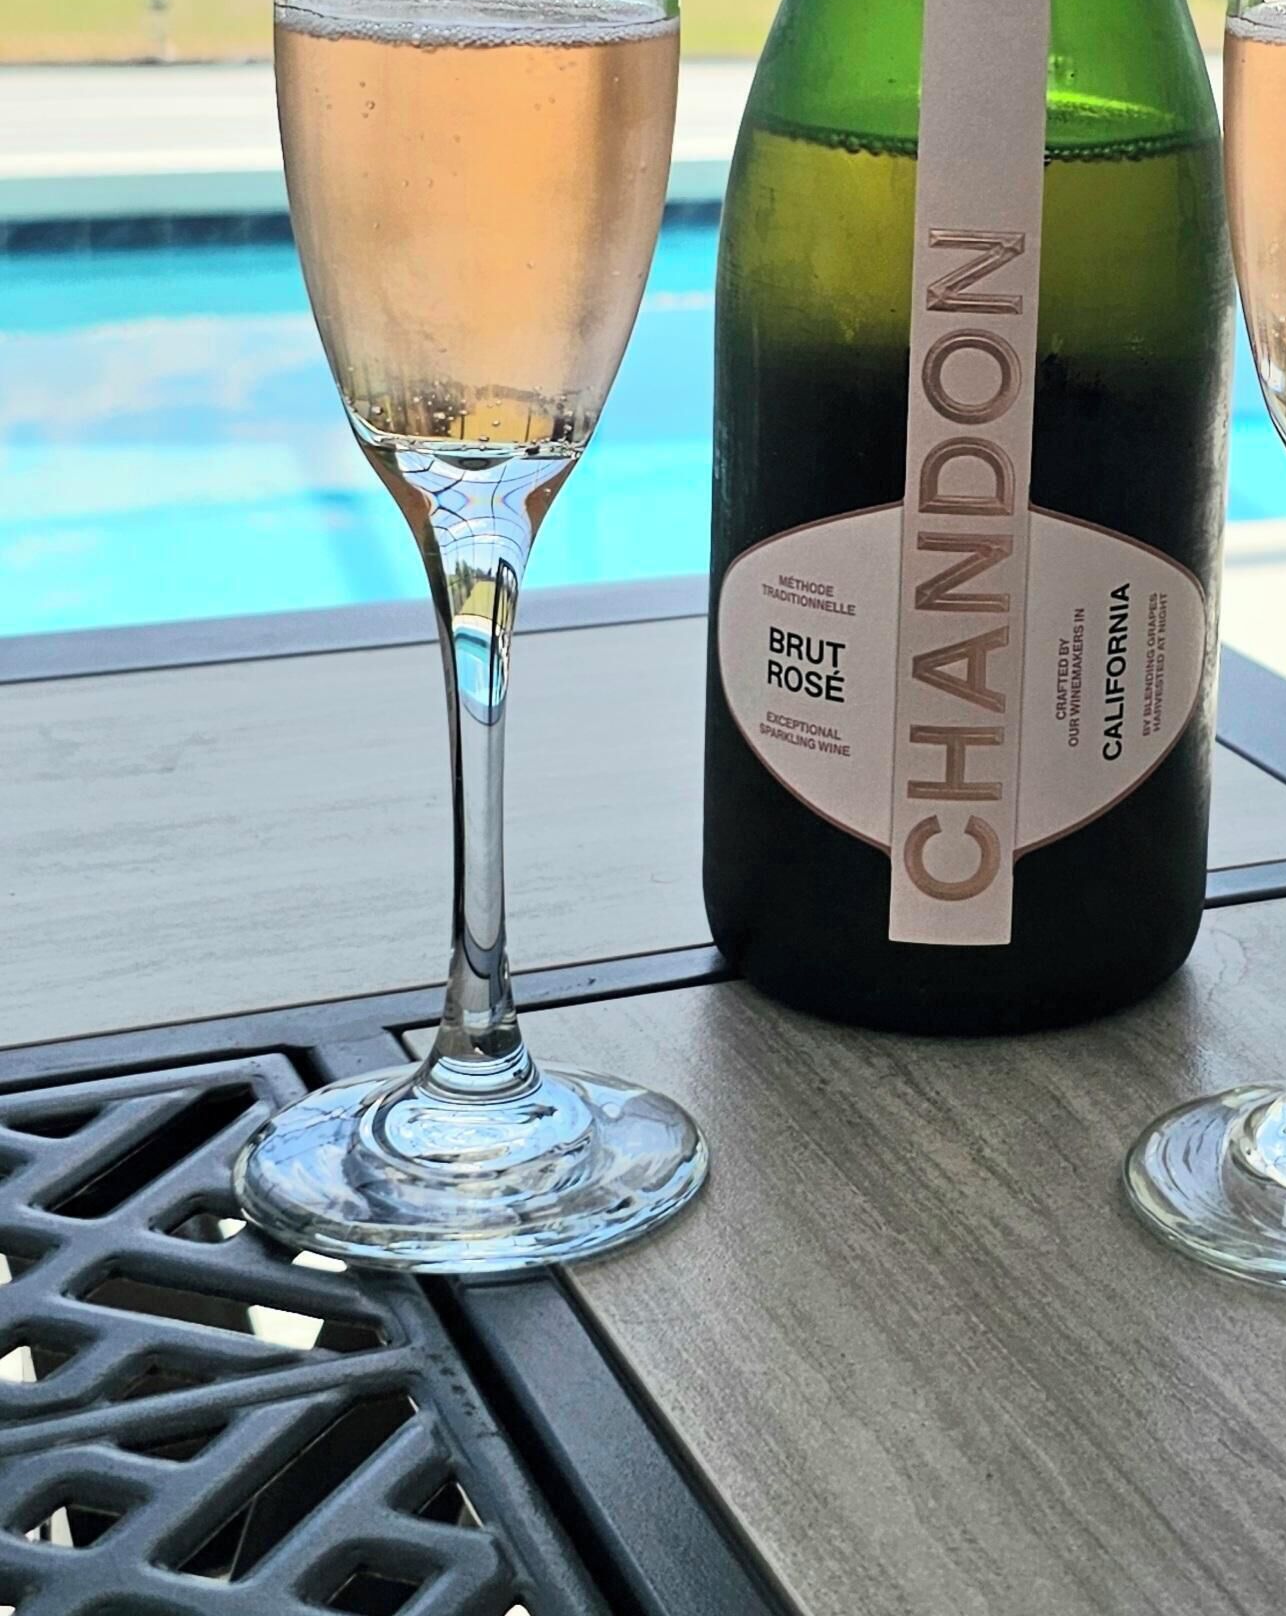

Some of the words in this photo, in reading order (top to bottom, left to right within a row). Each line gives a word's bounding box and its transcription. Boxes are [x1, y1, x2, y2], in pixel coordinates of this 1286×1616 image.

[903, 228, 1025, 901] CHANDON
[761, 583, 857, 616] TRADITIONNELLE
[778, 574, 834, 597] MÉTHODE
[1074, 608, 1085, 622] IN
[1147, 592, 1158, 646] GRAPES
[1158, 592, 1168, 633] NIGHT
[769, 626, 846, 668] BRUT
[1059, 638, 1070, 656] BY
[1157, 636, 1166, 651] AT
[767, 659, 845, 703] ROSÉ
[1056, 658, 1069, 720] CRAFTED
[1070, 625, 1084, 717] WINEMAKERS
[1103, 583, 1130, 761] CALIFORNIA
[1144, 650, 1155, 717] BLENDING
[1153, 654, 1165, 732] HARVESTED
[760, 722, 816, 750] SPARKLING
[818, 740, 851, 757] WINE
[766, 711, 842, 740] EXCEPTIONAL
[1068, 718, 1080, 747] OUR
[1142, 719, 1151, 736] BY
